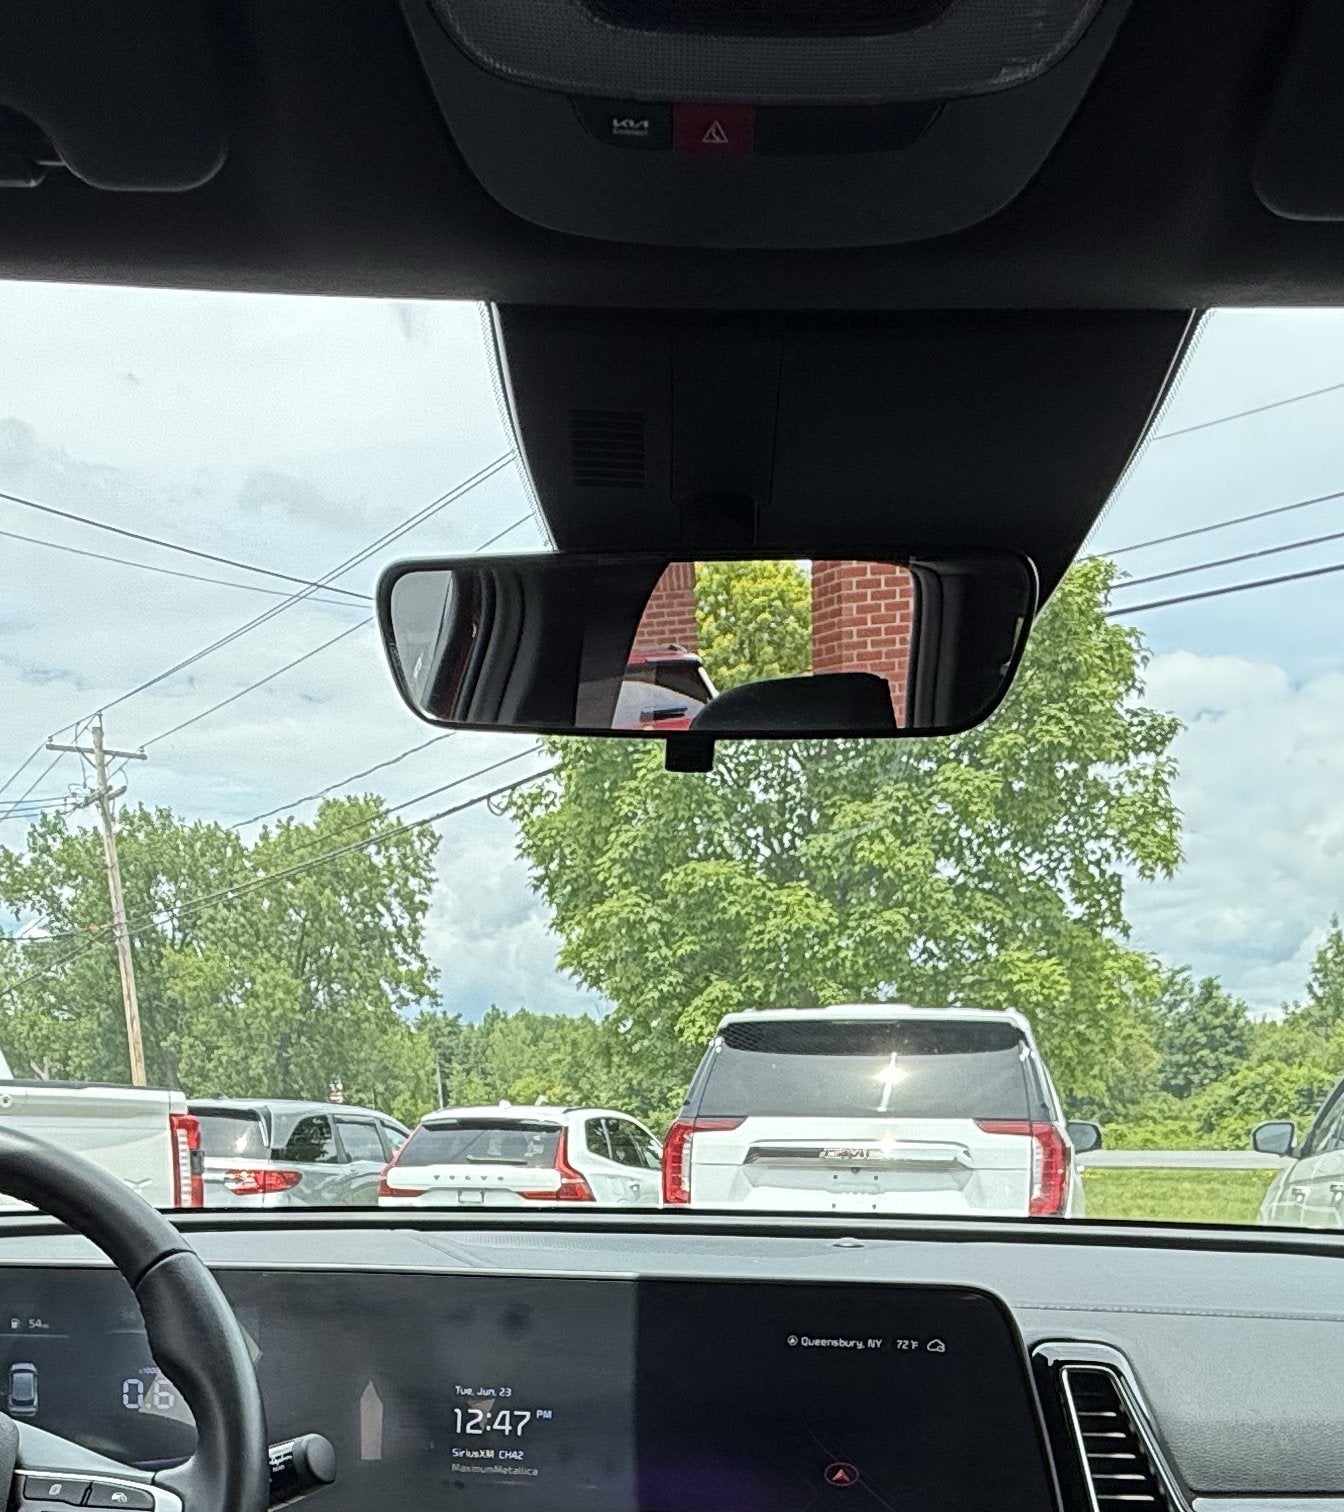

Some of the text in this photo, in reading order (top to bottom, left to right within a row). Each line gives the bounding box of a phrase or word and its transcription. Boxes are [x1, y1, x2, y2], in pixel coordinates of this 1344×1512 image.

[867, 1338, 884, 1349] NY
[122, 1378, 174, 1410] 0.6
[498, 1387, 513, 1397] 23
[453, 1407, 553, 1437] 12:47 PM
[451, 1447, 495, 1459] SiriusXM
